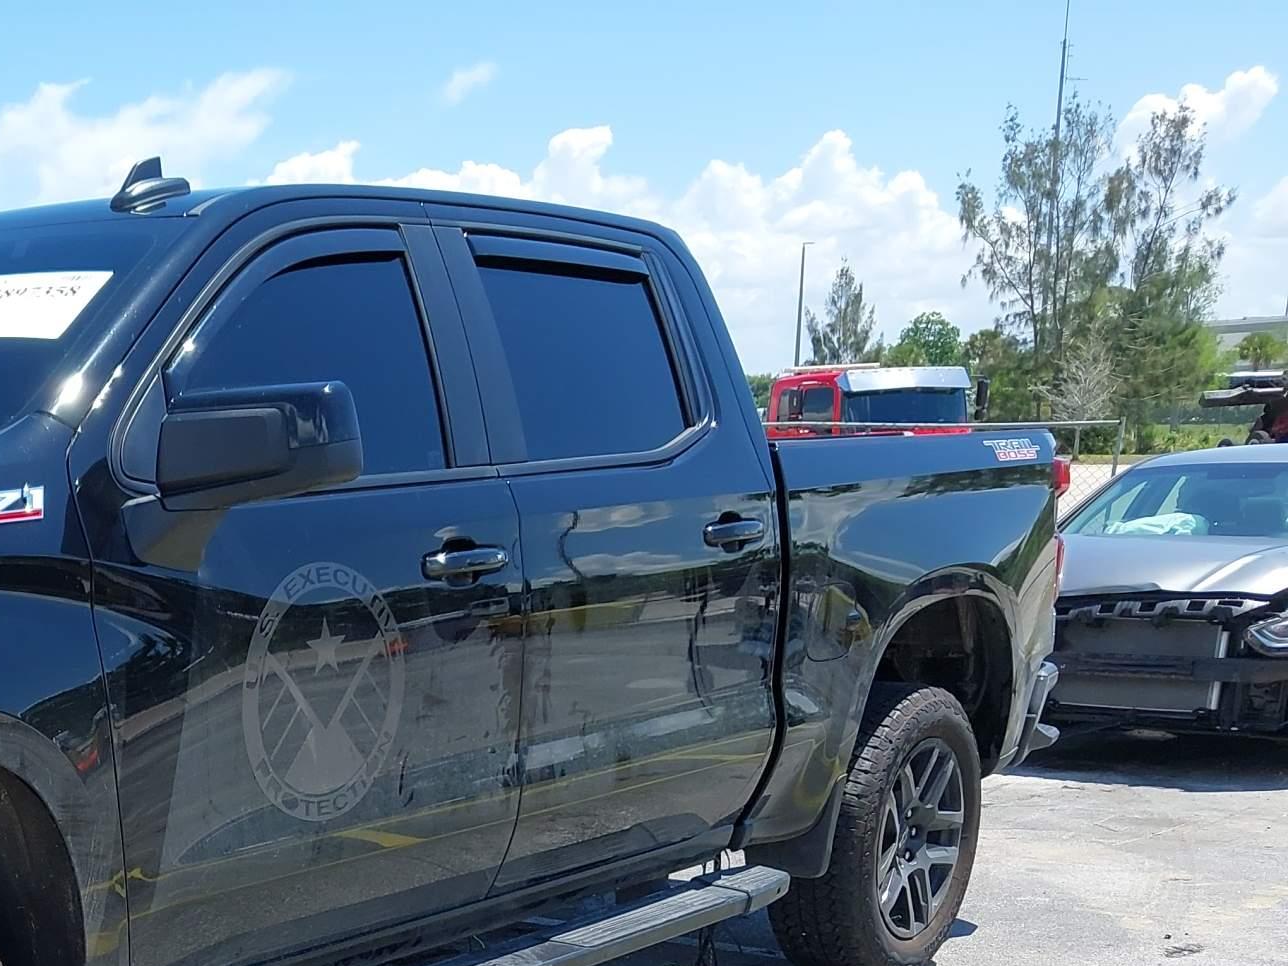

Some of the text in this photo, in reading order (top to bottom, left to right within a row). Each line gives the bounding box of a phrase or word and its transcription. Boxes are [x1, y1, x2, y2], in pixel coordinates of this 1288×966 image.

[982, 438, 1041, 452] TRAIL
[995, 449, 1039, 462] BOSS
[283, 565, 404, 661] EXECUTIVE
